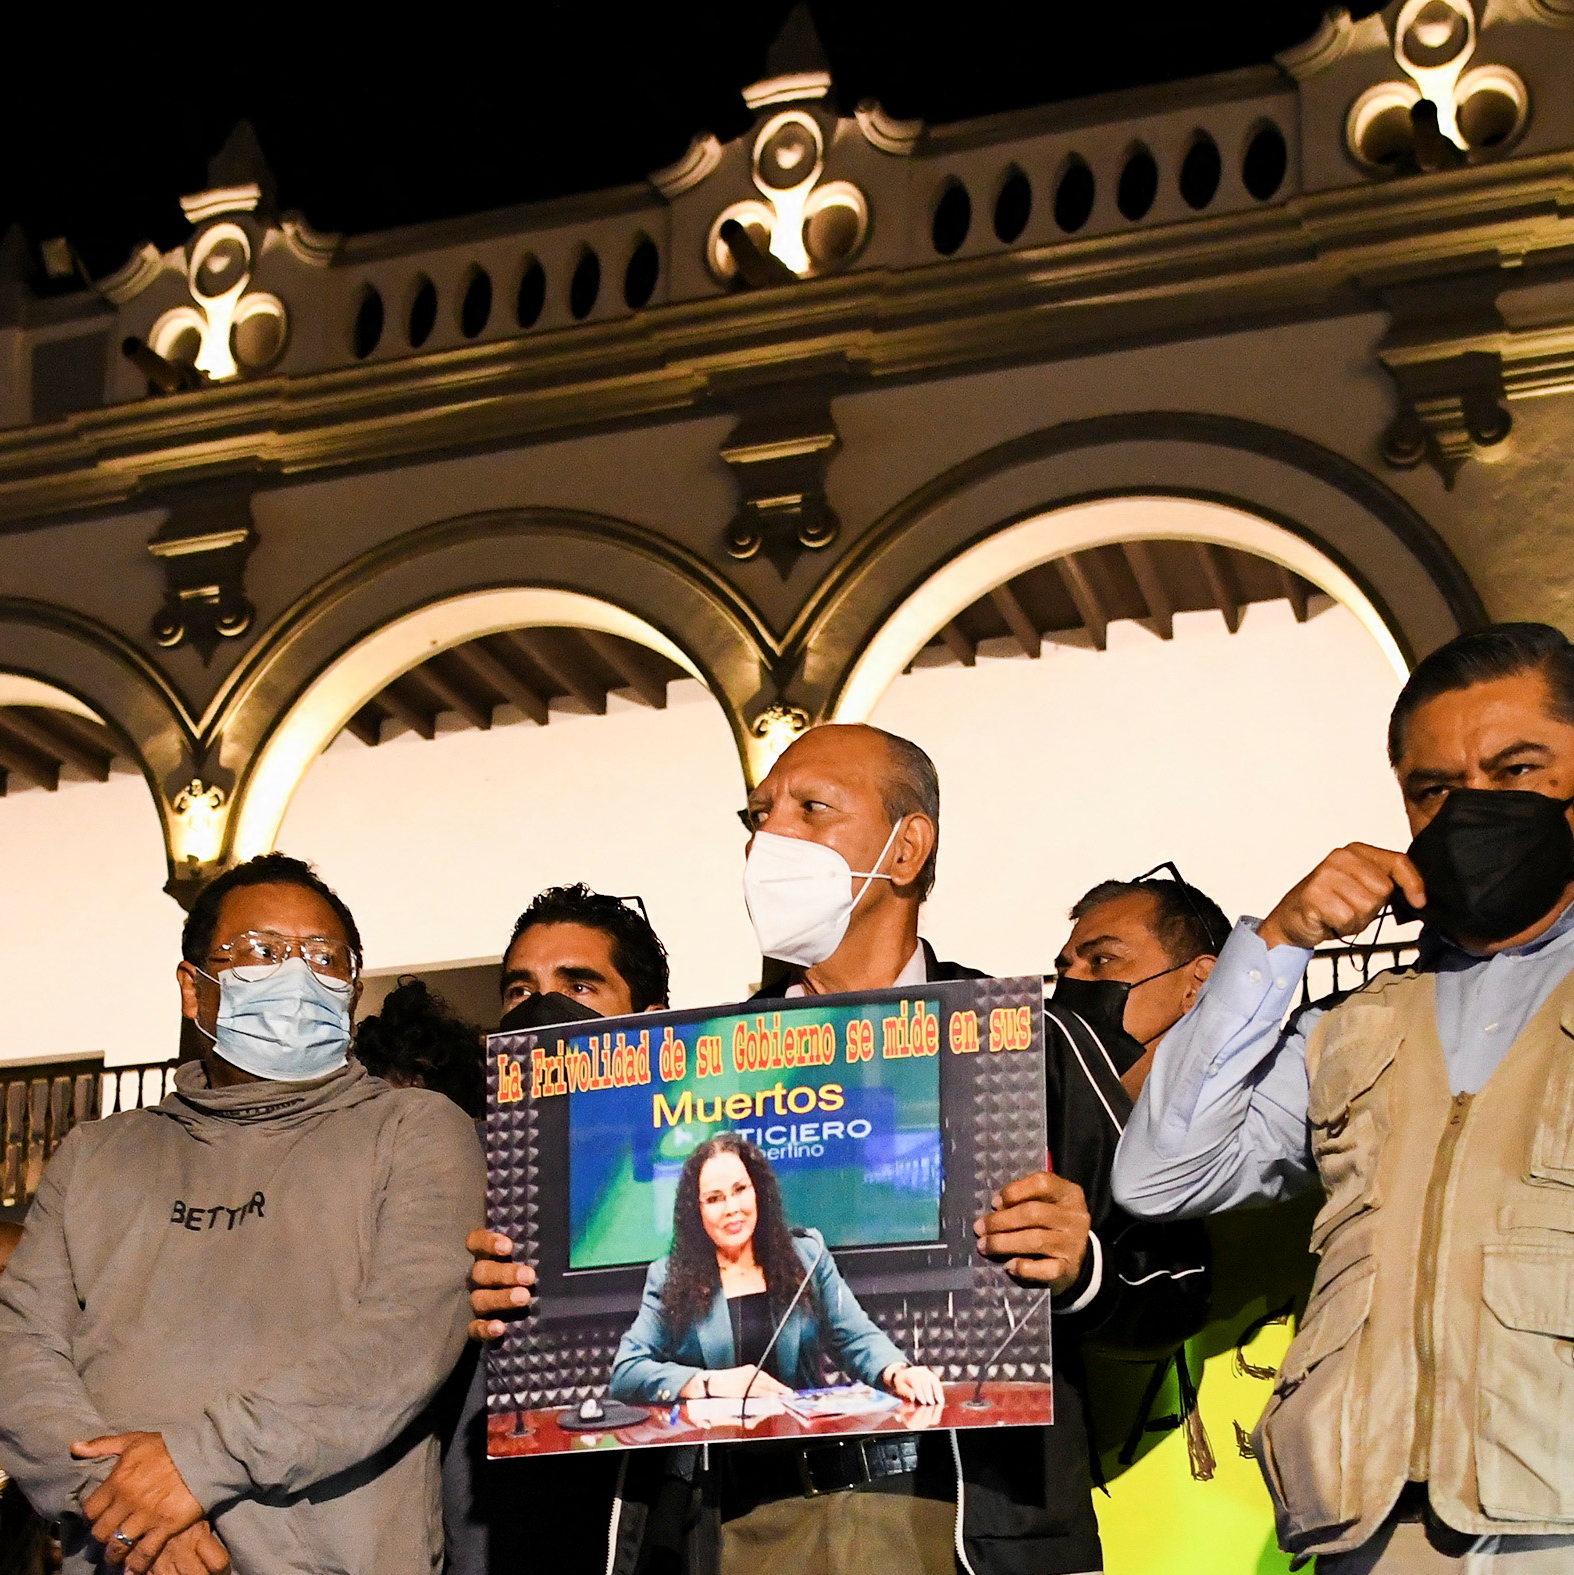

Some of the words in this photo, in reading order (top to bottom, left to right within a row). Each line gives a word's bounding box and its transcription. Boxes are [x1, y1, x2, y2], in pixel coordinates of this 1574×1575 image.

[497, 1054, 523, 1103] La
[531, 1030, 651, 1098] Frivolidad
[659, 1027, 687, 1082] de
[696, 1036, 723, 1079] su
[732, 1012, 836, 1073] Gobierno
[846, 1019, 874, 1064] se
[883, 1000, 939, 1059] mide
[949, 1010, 979, 1055] en
[989, 1006, 1032, 1052] sus
[652, 1082, 846, 1128] Muertos
[674, 1118, 873, 1148] NTICIERO
